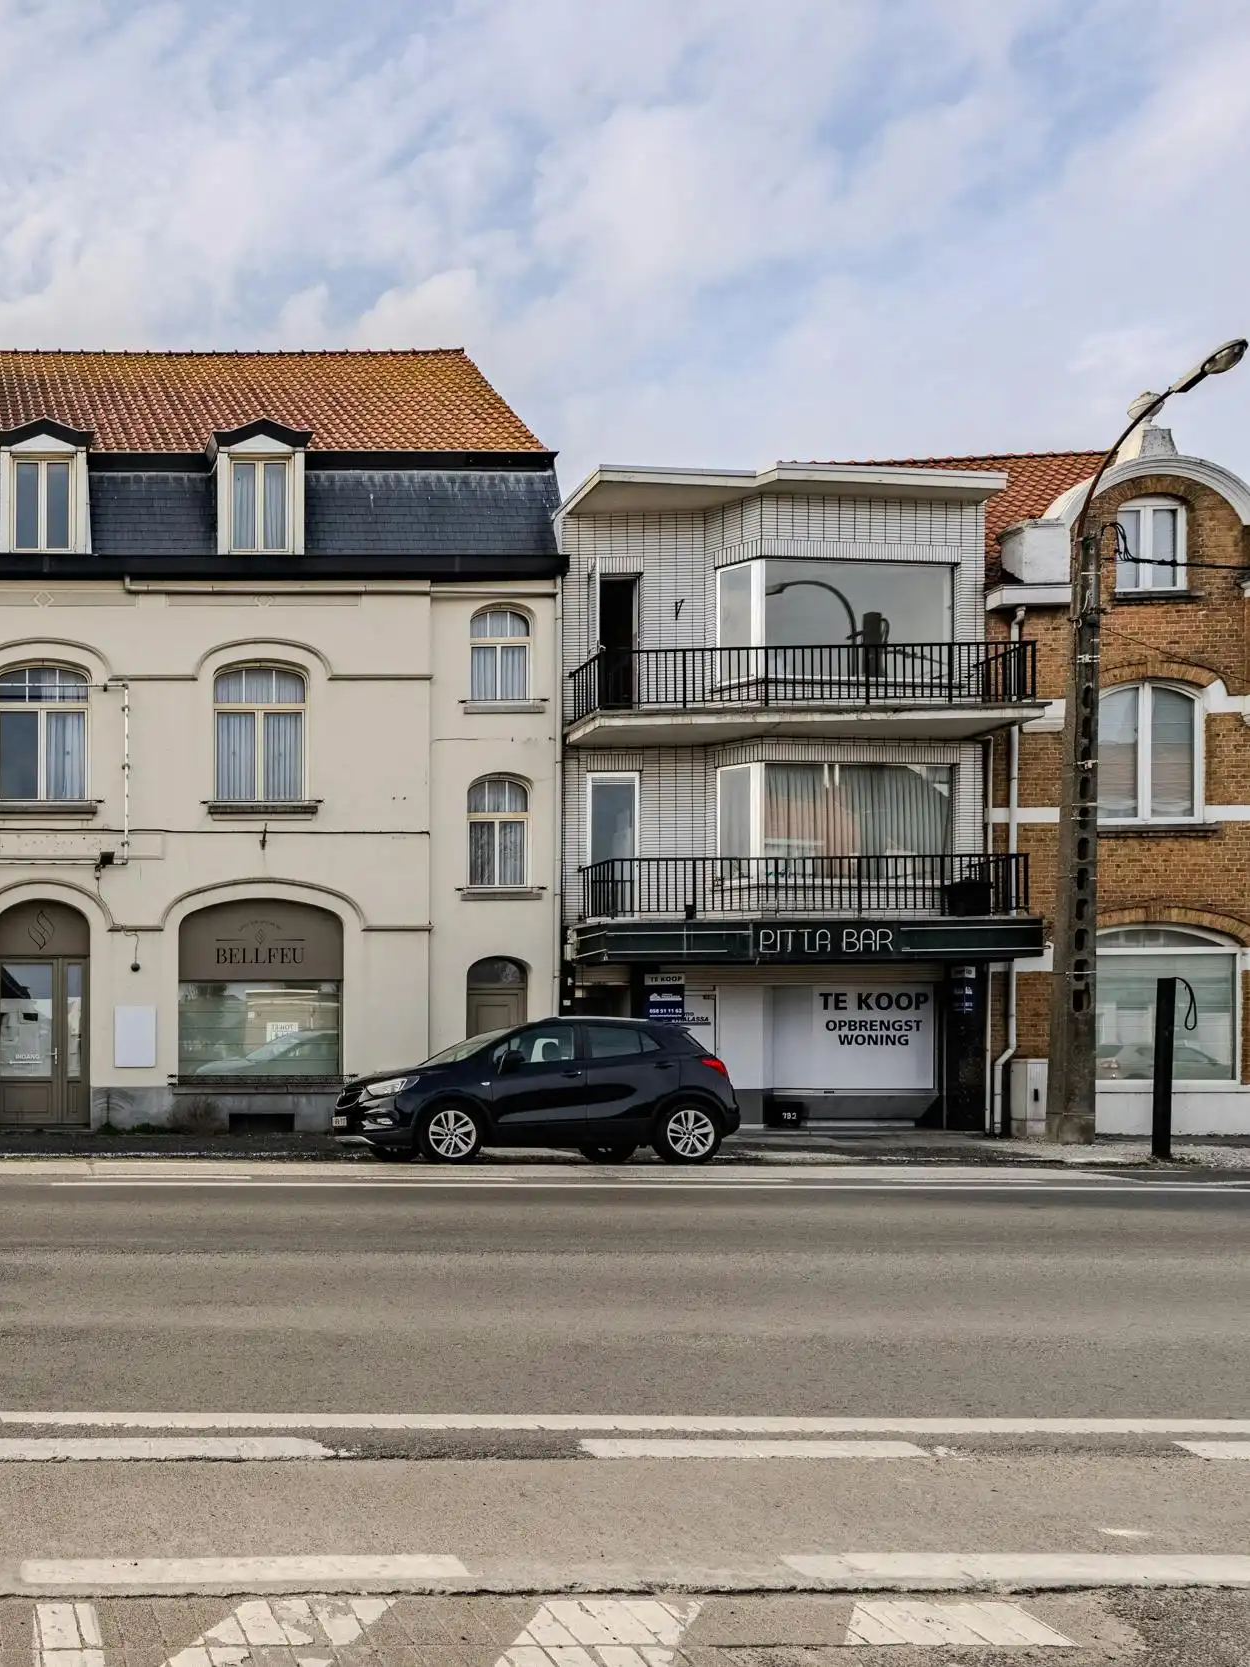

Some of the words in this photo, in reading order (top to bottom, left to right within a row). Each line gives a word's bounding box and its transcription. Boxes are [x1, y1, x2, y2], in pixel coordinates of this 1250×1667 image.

[759, 929, 831, 953] PITTA
[842, 928, 894, 952] BAR
[215, 947, 305, 965] BELLFEU
[819, 992, 848, 1011] TE
[857, 992, 929, 1011] KOOP
[825, 1019, 922, 1032] OPBRENGST
[838, 1034, 909, 1046] WONING
